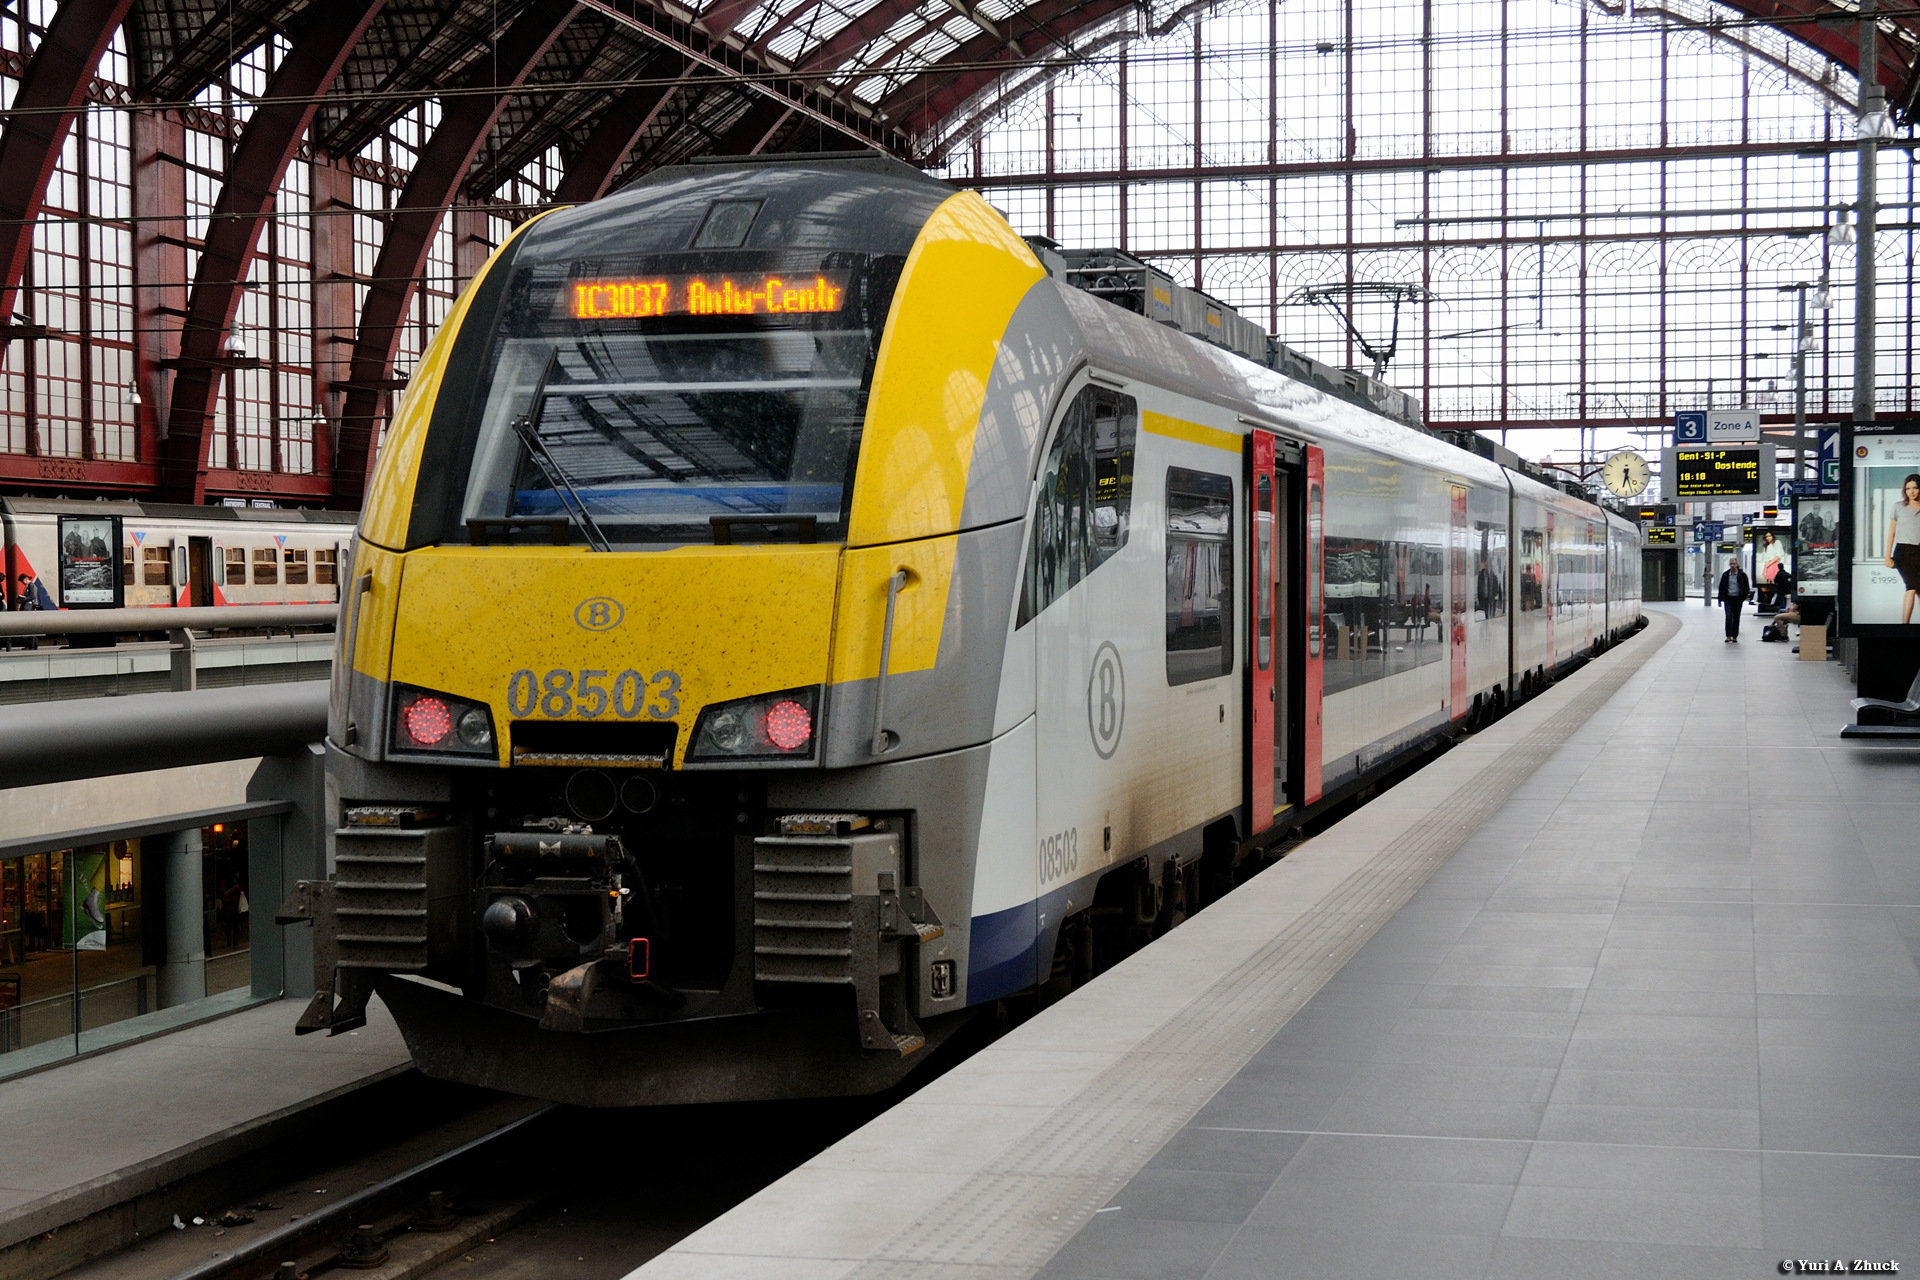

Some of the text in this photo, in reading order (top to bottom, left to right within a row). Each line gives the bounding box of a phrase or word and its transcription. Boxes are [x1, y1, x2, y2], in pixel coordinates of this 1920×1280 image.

[576, 278, 841, 317] IC3037 Antw-Centr
[1685, 421, 1697, 437] 3
[1714, 421, 1752, 430] Zone A
[1715, 461, 1757, 469] Oostende
[1746, 471, 1757, 479] IC
[587, 601, 611, 627] B
[507, 668, 682, 719] 08503
[1099, 658, 1116, 741] B
[1039, 827, 1078, 885] 08503
